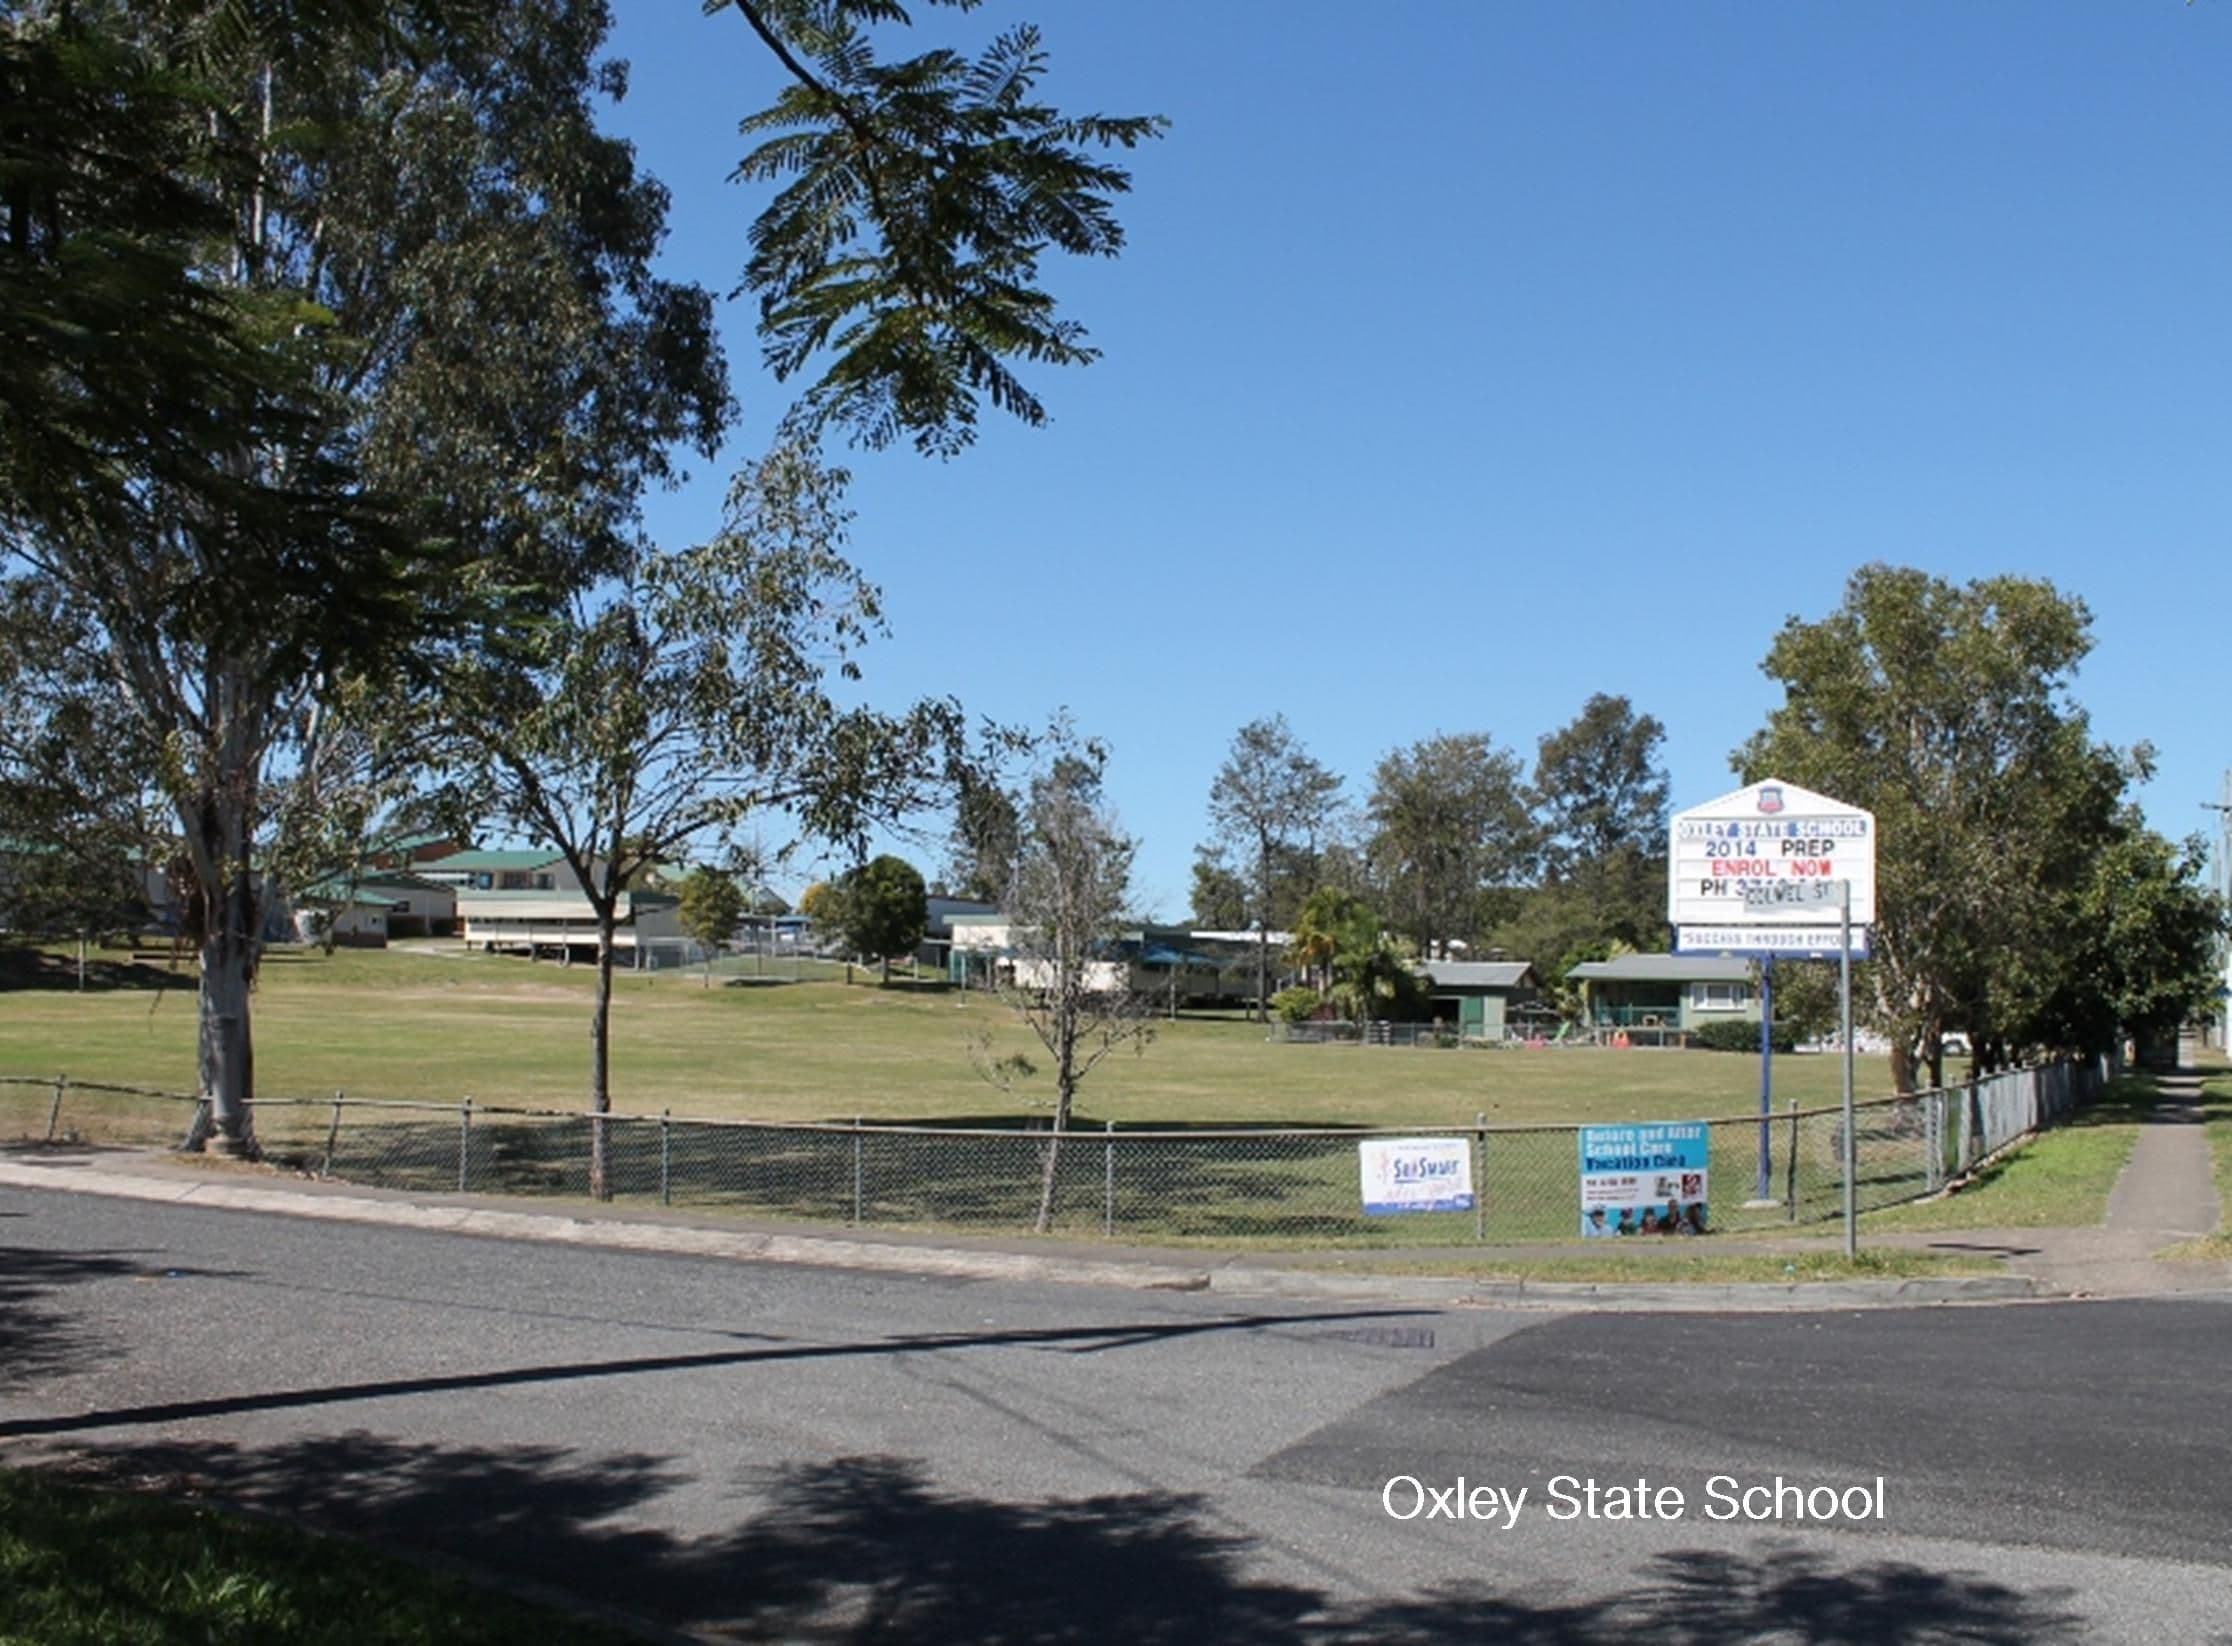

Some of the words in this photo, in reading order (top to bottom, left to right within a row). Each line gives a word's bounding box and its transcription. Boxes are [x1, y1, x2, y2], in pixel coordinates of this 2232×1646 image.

[1705, 840, 1757, 857] 2014
[1781, 839, 1835, 857] PREP
[1711, 860, 1776, 877] ENROL
[1791, 859, 1832, 876] NOW
[1701, 879, 1727, 896] PH
[1639, 1127, 1664, 1140] and
[1586, 1143, 1635, 1157] School
[1640, 1142, 1672, 1155] Care
